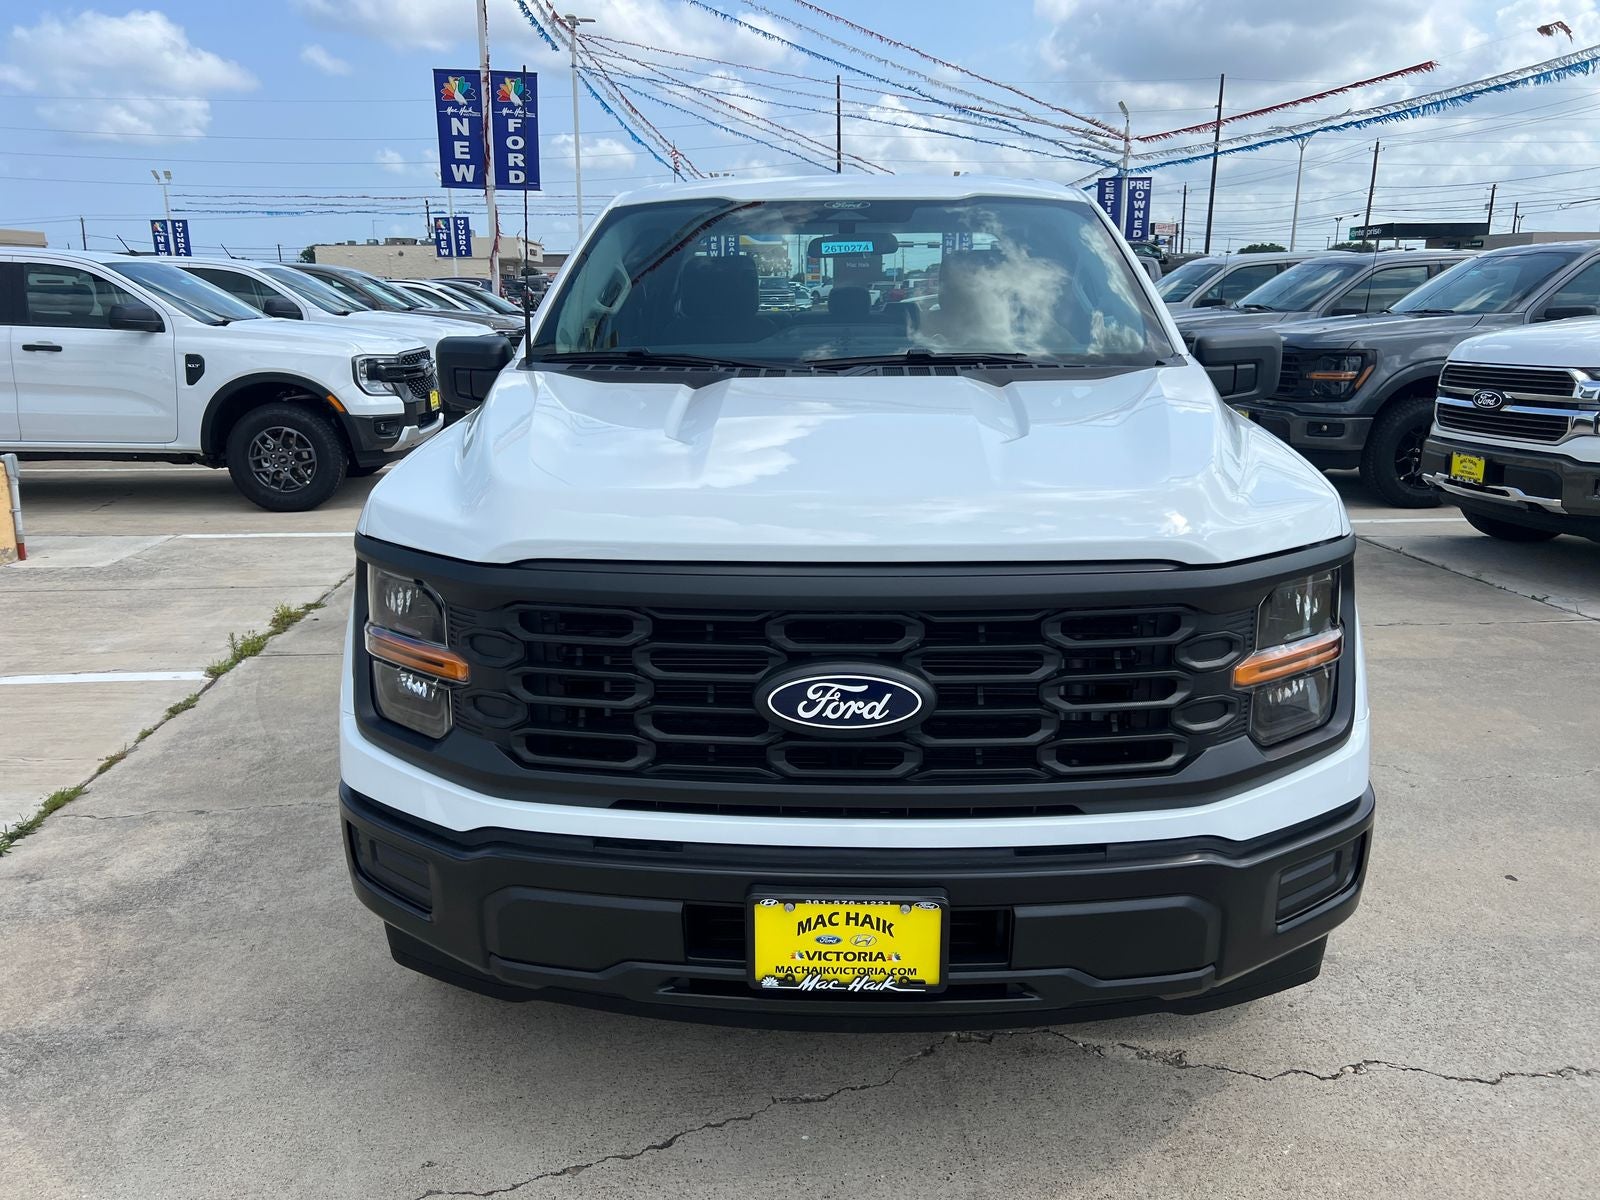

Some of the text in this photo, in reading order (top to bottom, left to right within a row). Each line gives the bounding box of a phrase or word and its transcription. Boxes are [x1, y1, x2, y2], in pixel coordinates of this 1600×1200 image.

[450, 118, 475, 182] NEW
[505, 119, 525, 184] FORD
[1129, 180, 1150, 190] PRE
[1133, 190, 1146, 238] OWNED
[175, 222, 186, 256] HYUNDAI
[457, 219, 467, 255] HYUNDAI
[1351, 227, 1382, 237] enteprise
[157, 236, 168, 256] NEW
[439, 233, 449, 256] NEW
[710, 236, 718, 257] NEW
[824, 244, 869, 253] 26T0274
[1478, 393, 1497, 406] Ford
[797, 682, 892, 720] Ford
[797, 911, 895, 938] MAC HAIK
[819, 936, 838, 944] Ford
[805, 950, 887, 962] VICTORIA
[775, 965, 918, 976] MACHAIKVICTORIA.COM
[800, 974, 897, 992] Mac Haik
